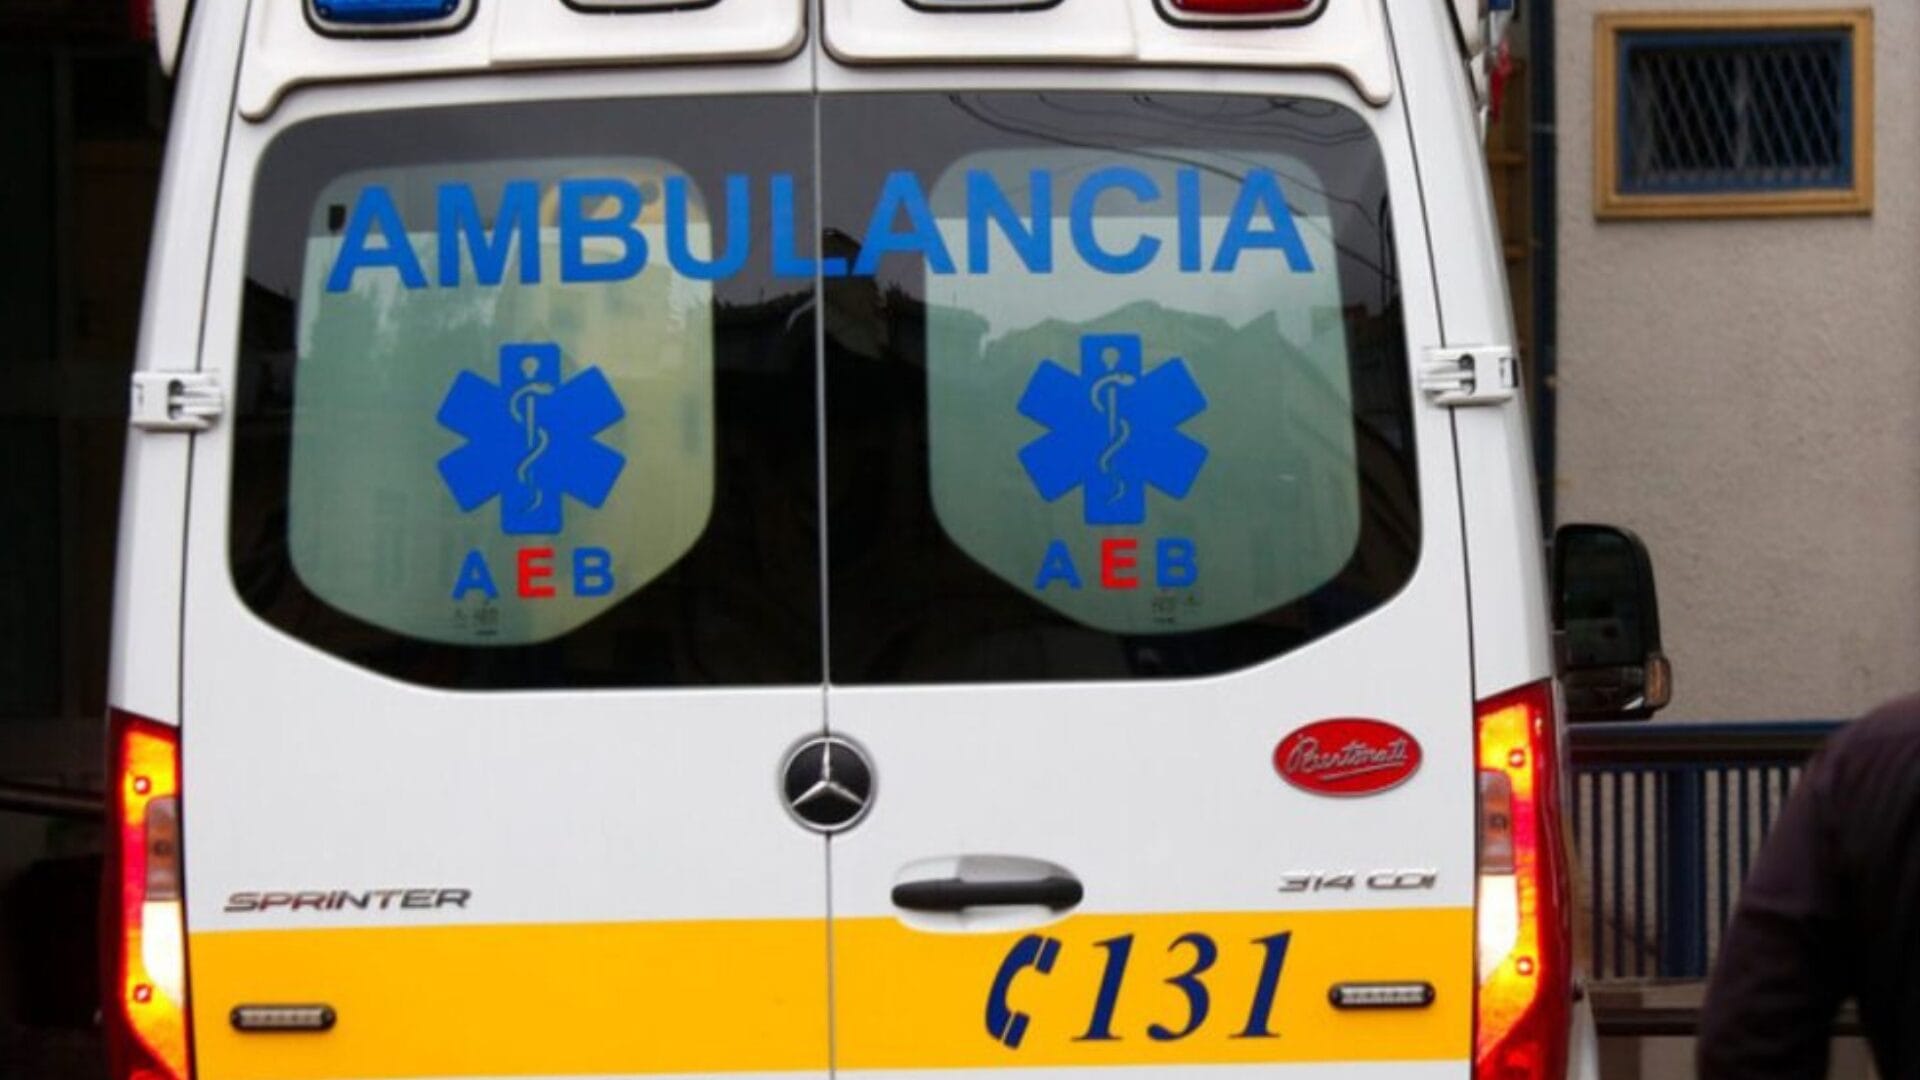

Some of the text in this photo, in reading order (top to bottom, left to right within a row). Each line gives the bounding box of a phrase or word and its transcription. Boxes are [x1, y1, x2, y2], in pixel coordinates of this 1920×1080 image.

[326, 168, 1314, 291] AMBULANCIA
[452, 547, 615, 600] AEB
[1034, 537, 1199, 590] AEB
[224, 888, 472, 913] SPRINTER
[1278, 867, 1440, 892] 314 CDI
[1070, 930, 1292, 1042] 131
